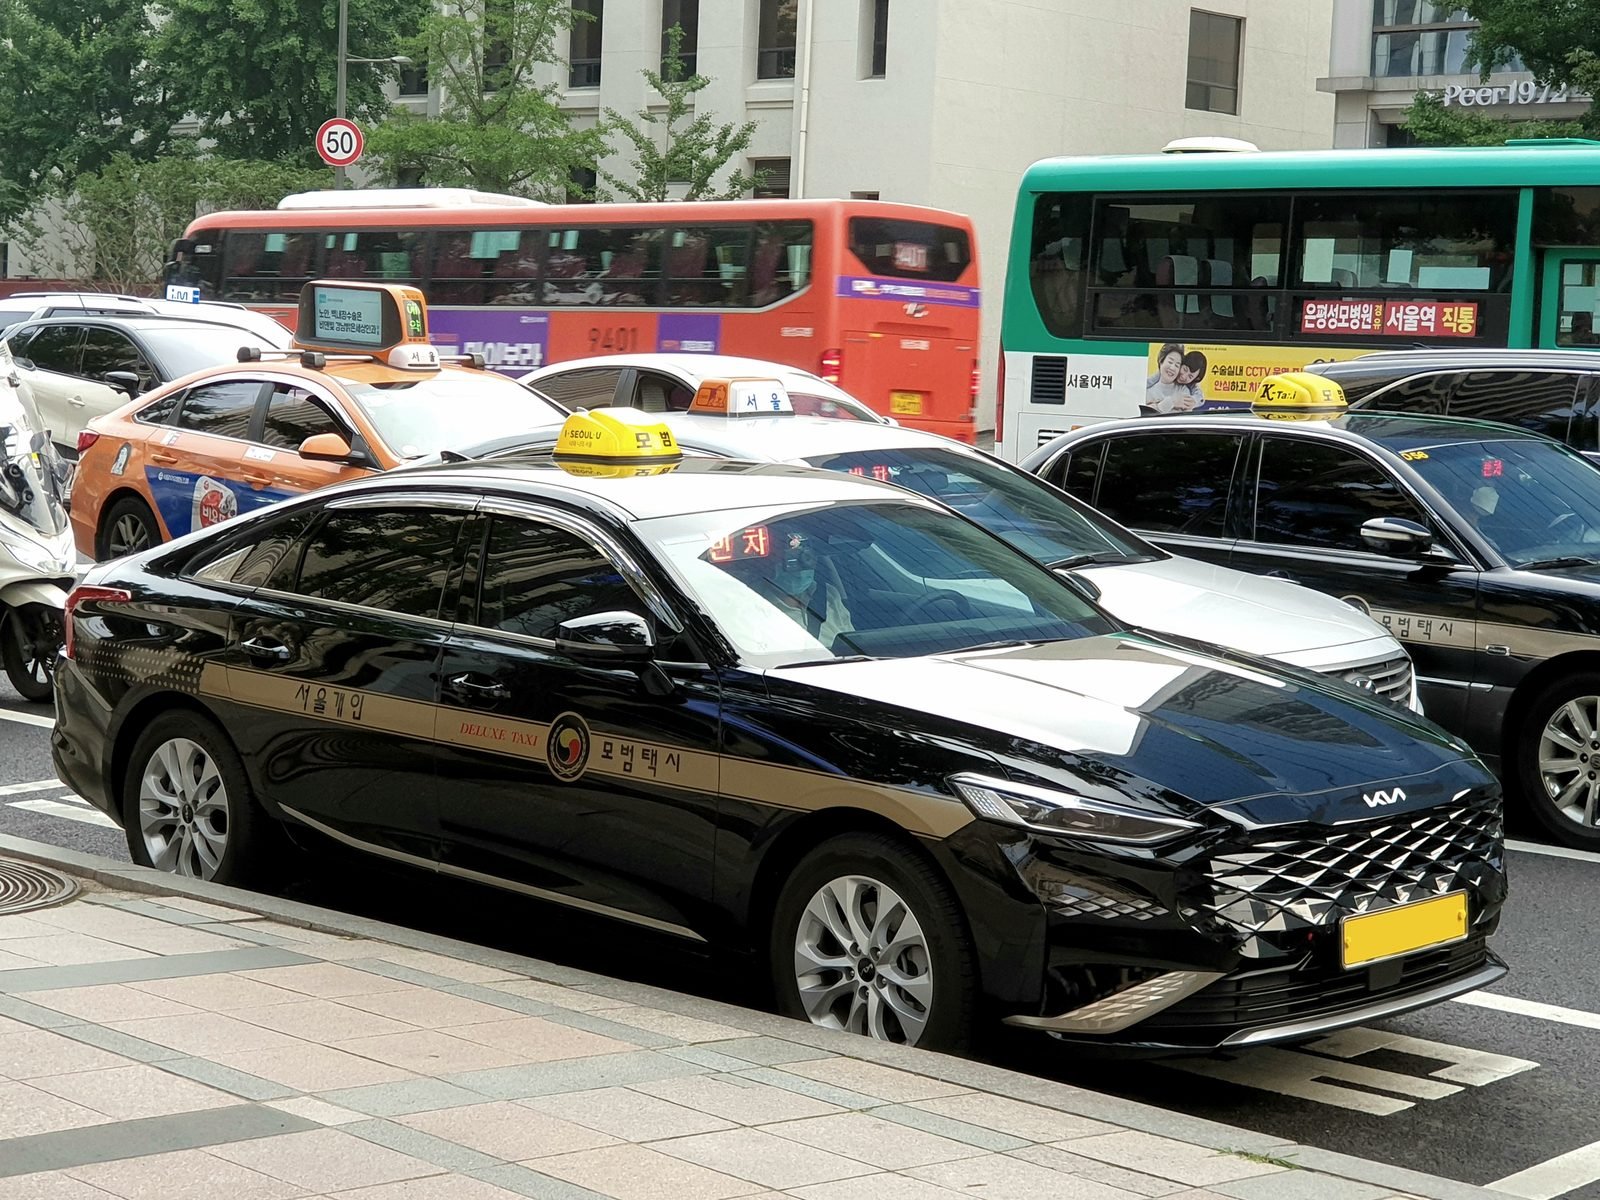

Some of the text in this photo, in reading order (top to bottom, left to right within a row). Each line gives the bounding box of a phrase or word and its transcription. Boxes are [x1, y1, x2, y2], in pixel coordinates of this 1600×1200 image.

[326, 131, 353, 154] 50
[1304, 303, 1383, 330] 은평성모병원 경유
[1386, 305, 1475, 333] 서울역 직통
[1067, 374, 1112, 390] 서울여객
[1245, 366, 1271, 377] CCTV
[1214, 380, 1246, 392] 안심하고
[747, 393, 781, 411] 서울
[634, 431, 672, 449] 모범
[711, 528, 767, 561] 빈차
[1382, 615, 1453, 640] 모범택시
[294, 684, 365, 721] 서울개인
[460, 722, 539, 748] DELUXE TAXI
[601, 741, 681, 777] 모범택시
